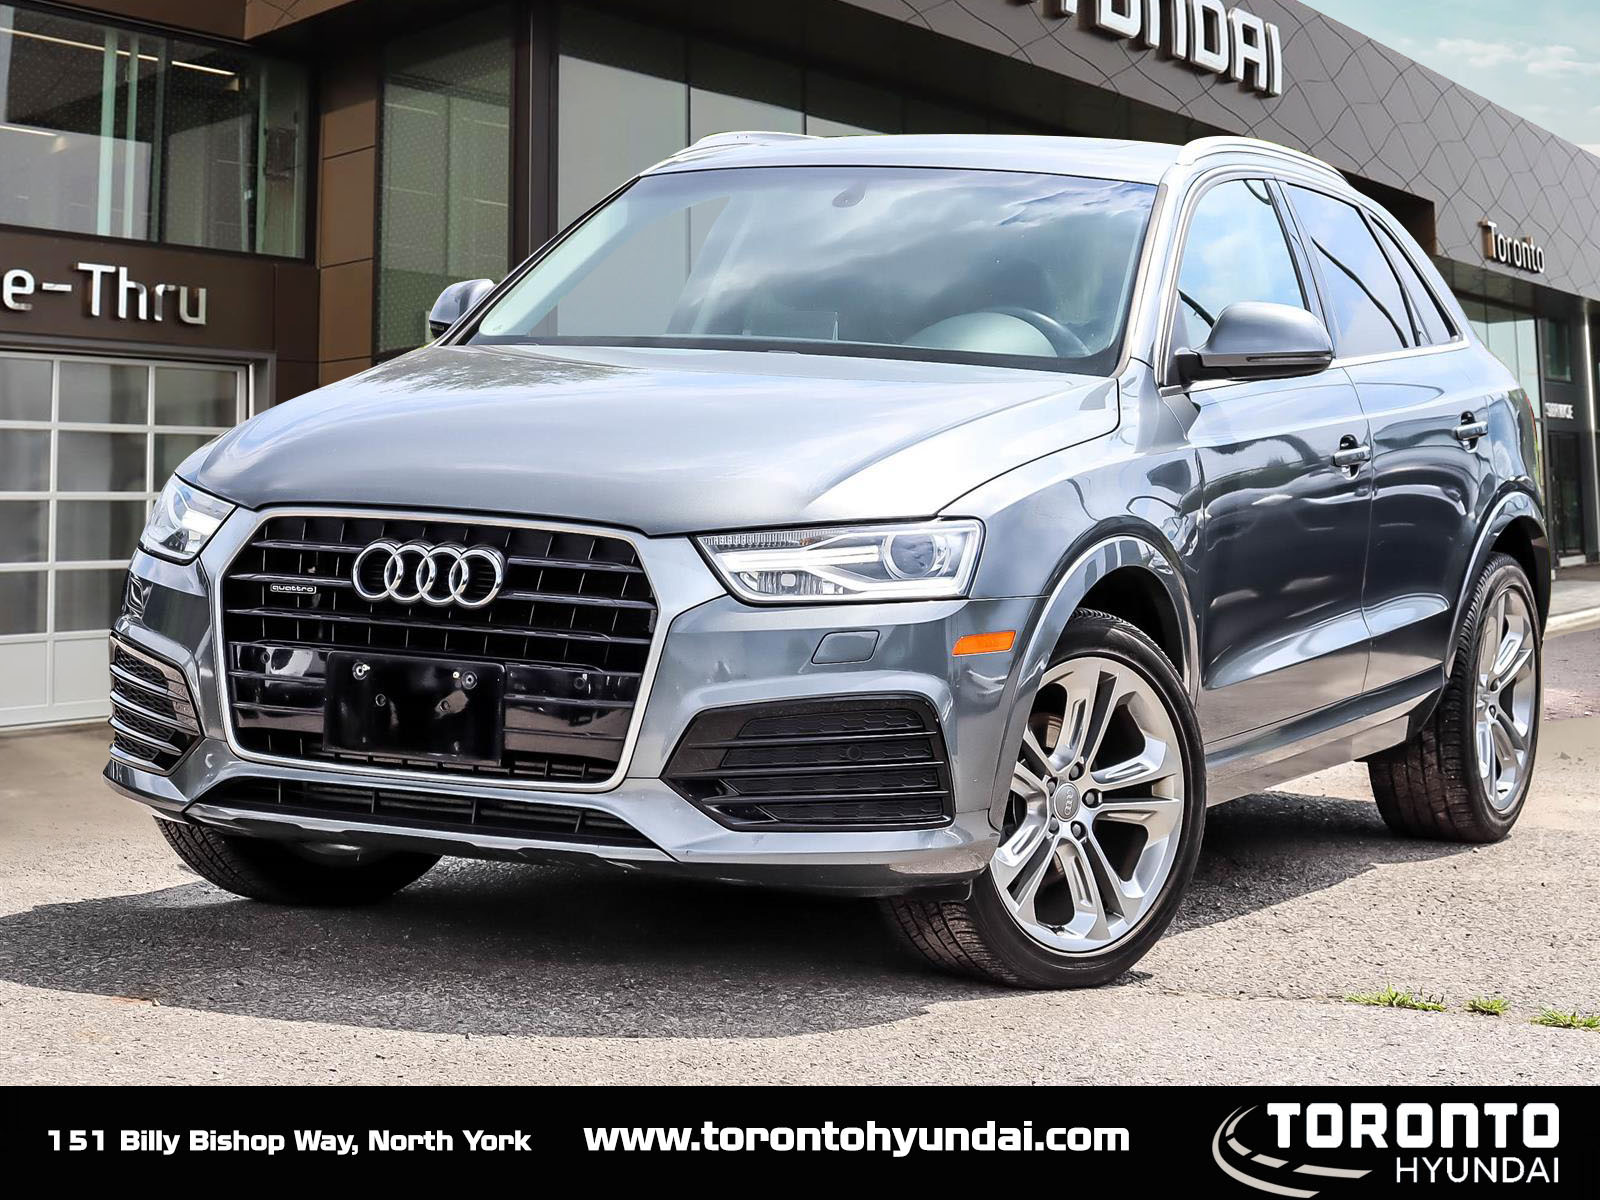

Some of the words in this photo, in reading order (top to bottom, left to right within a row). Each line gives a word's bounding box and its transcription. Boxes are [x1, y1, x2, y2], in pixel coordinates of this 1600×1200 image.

[1061, 0, 1282, 96] UNDAI
[1486, 220, 1545, 273] Toronto
[2, 262, 207, 325] e-Thru
[271, 584, 315, 592] quattro
